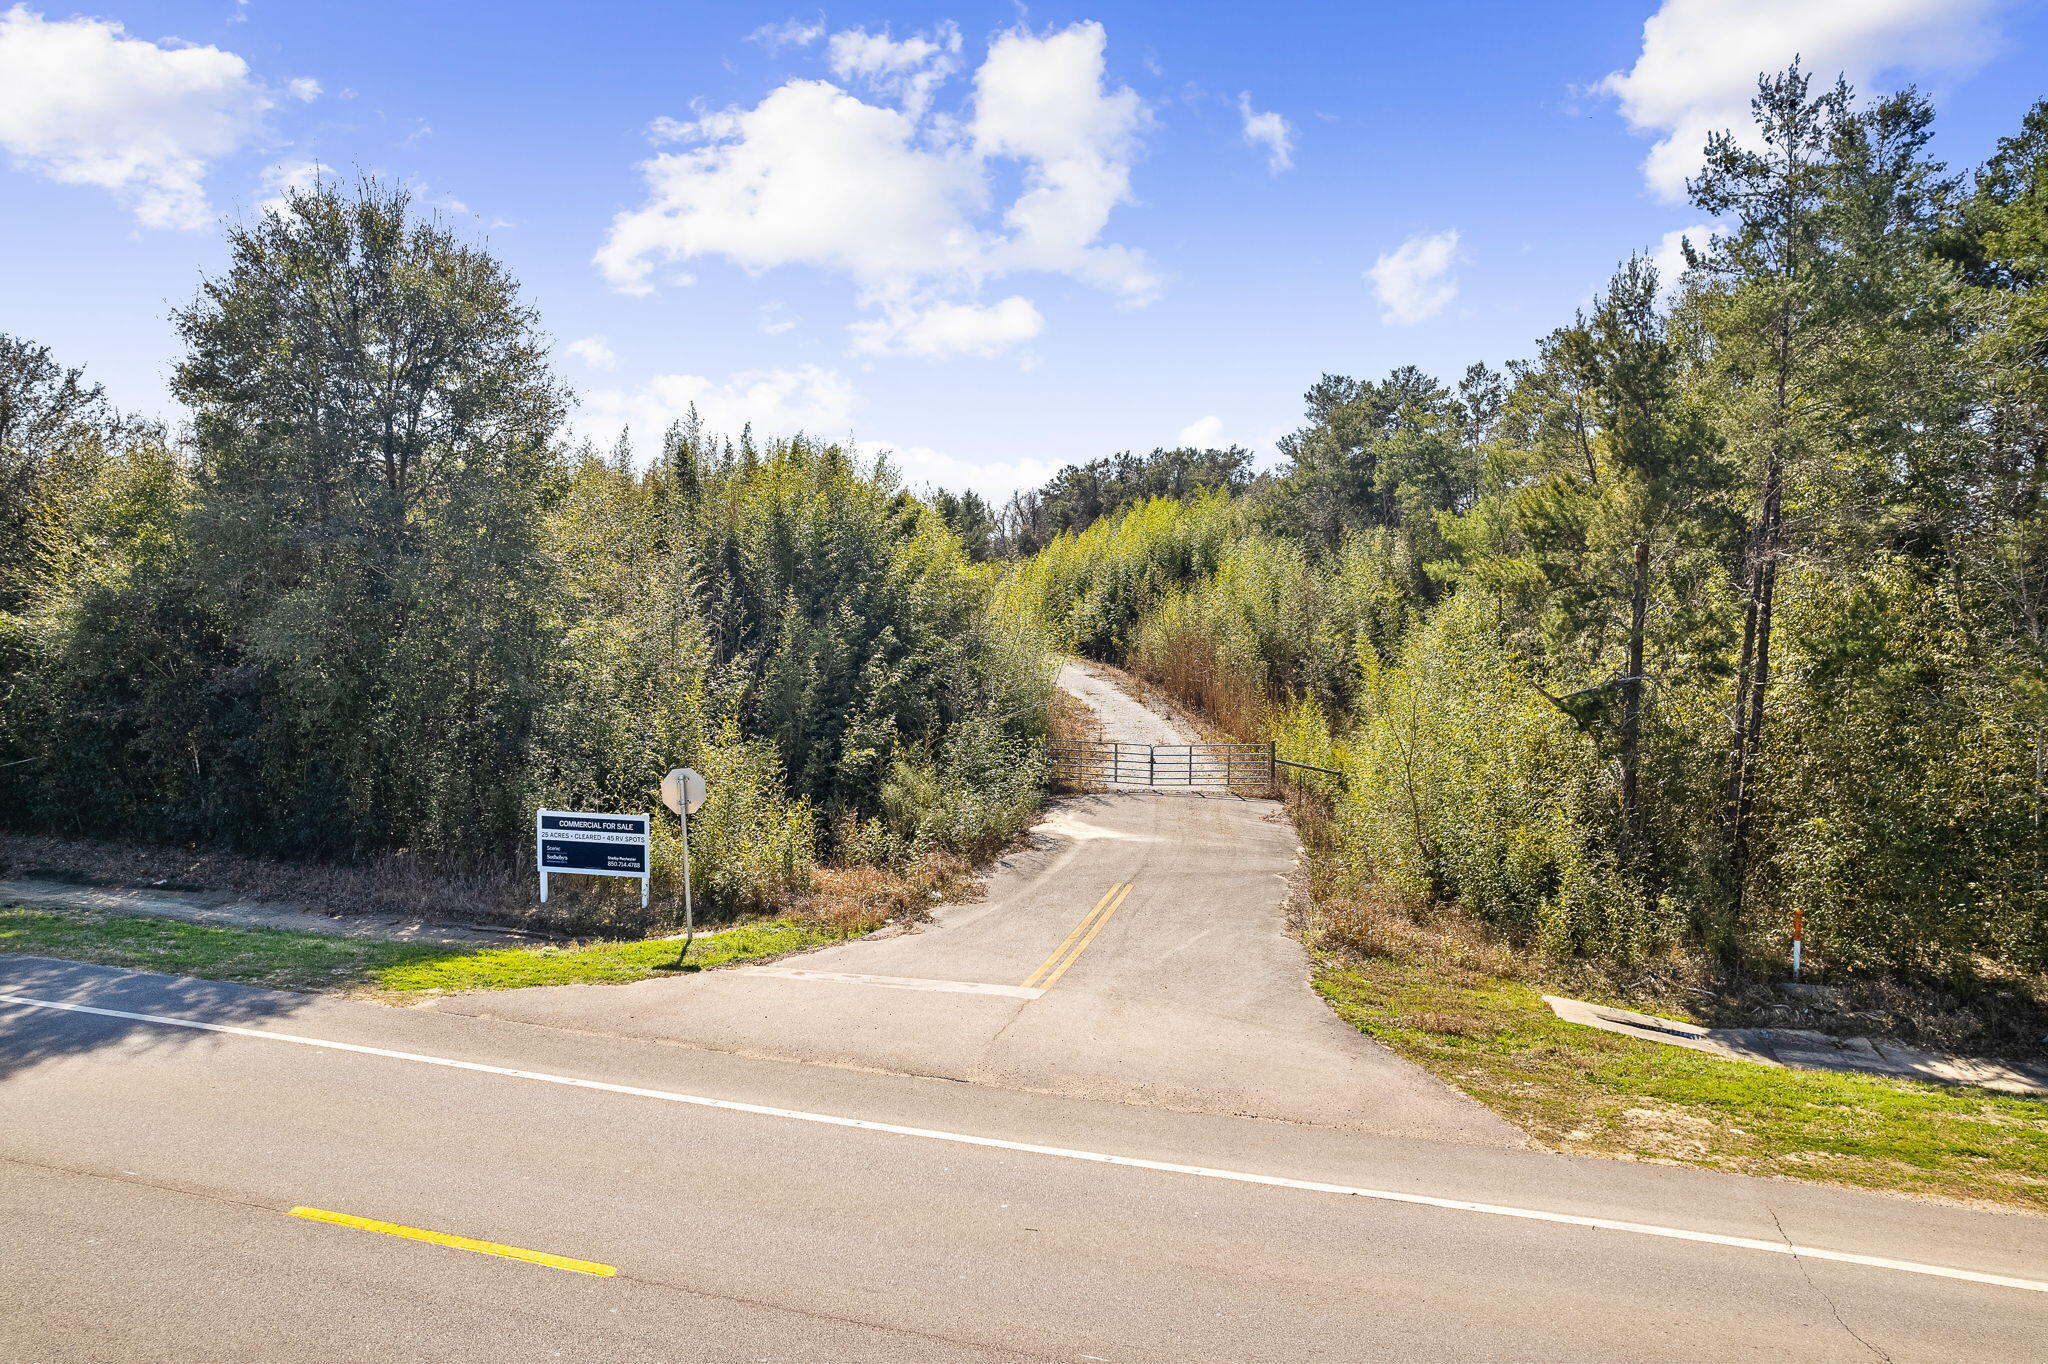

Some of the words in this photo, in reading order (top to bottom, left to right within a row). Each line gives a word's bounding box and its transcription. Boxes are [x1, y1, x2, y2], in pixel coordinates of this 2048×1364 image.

[559, 820, 601, 829] COMMERCIAL
[603, 822, 616, 830] FOR
[617, 823, 633, 831] SALE
[574, 833, 602, 841] CLEARED
